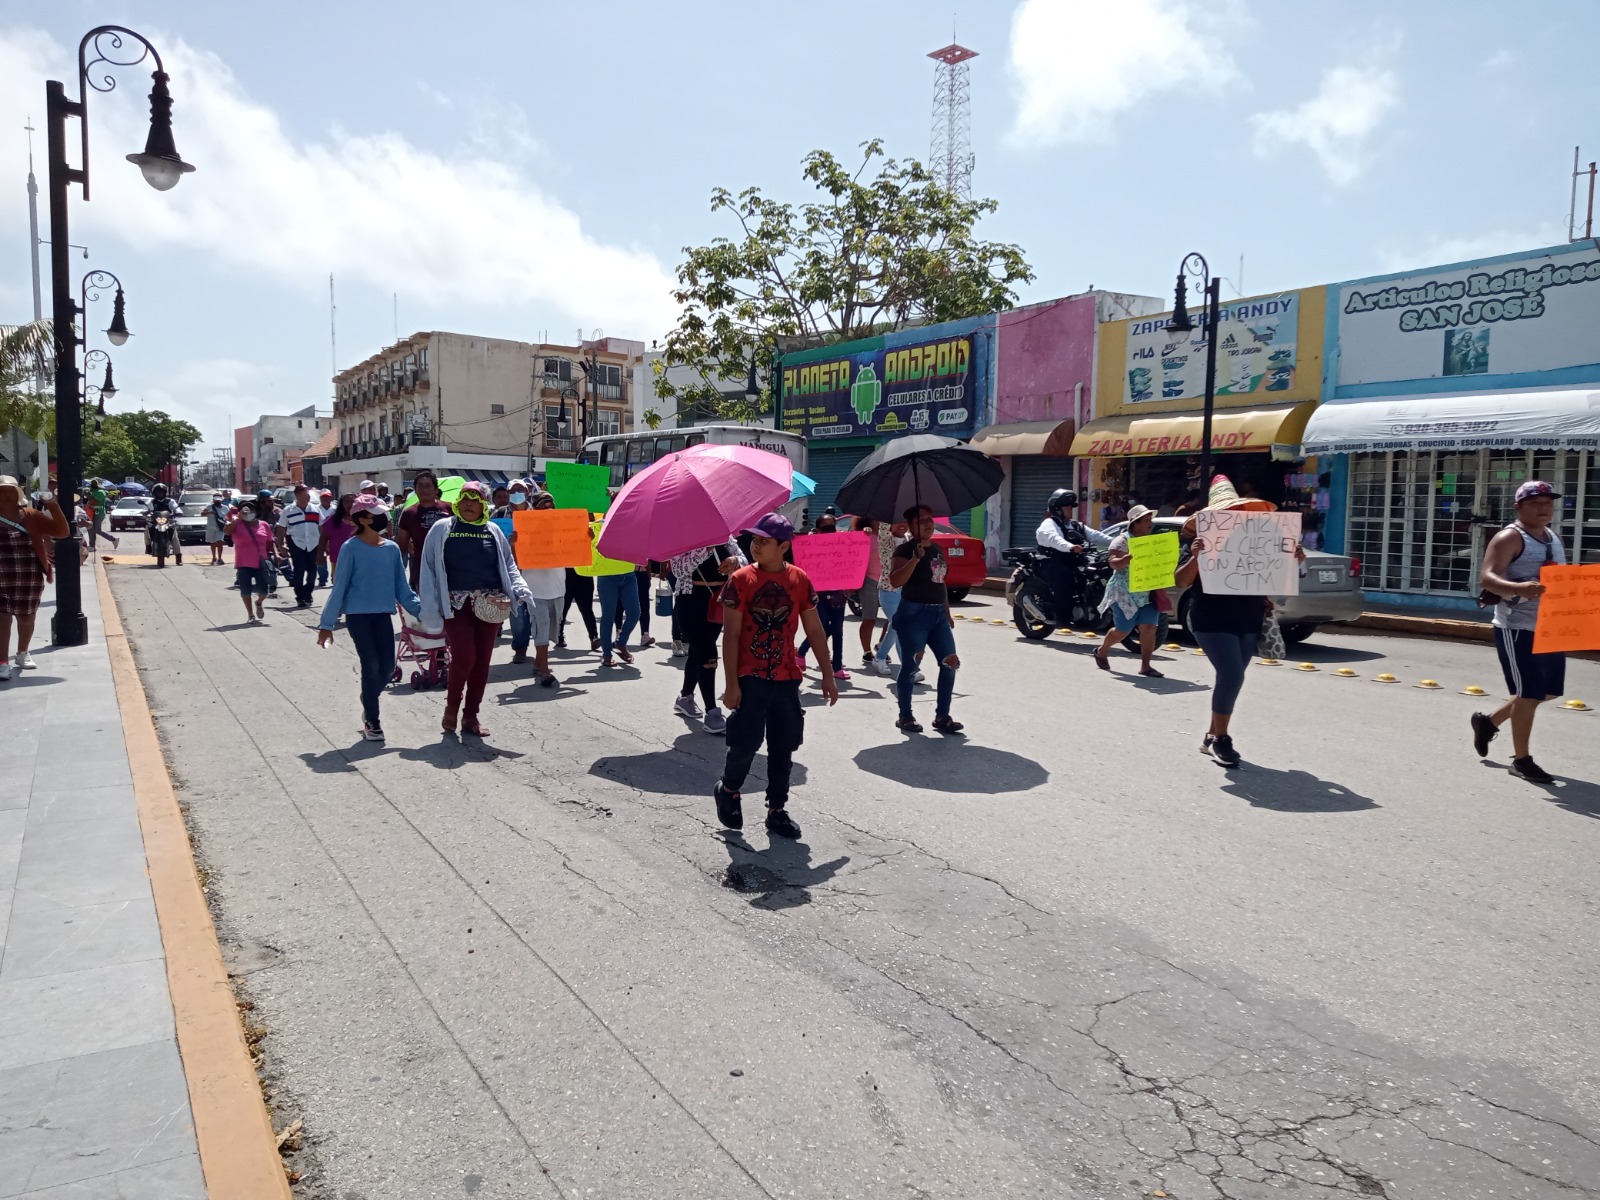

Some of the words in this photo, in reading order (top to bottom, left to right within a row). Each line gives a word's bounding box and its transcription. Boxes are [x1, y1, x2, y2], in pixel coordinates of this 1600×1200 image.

[1237, 298, 1292, 319] ANDY
[1400, 304, 1461, 331] SAN
[1462, 293, 1545, 325] JOSÉ
[884, 339, 971, 384] ANDROID
[1133, 347, 1154, 360] FILA
[783, 360, 850, 397] PLANETA
[889, 391, 927, 407] CELULARES
[740, 441, 787, 456] MANIGUA
[1372, 441, 1412, 449] VELADORAS
[1418, 440, 1455, 448] CRUCIFIJO
[1461, 438, 1514, 446] ESCAPULARIO
[1520, 438, 1560, 446] CUADROS
[1567, 438, 1599, 446] VIRGEN
[1199, 535, 1232, 555] DEL
[1201, 557, 1228, 571] CON
[1236, 555, 1283, 572] APOYO
[1225, 571, 1277, 591] CTM
